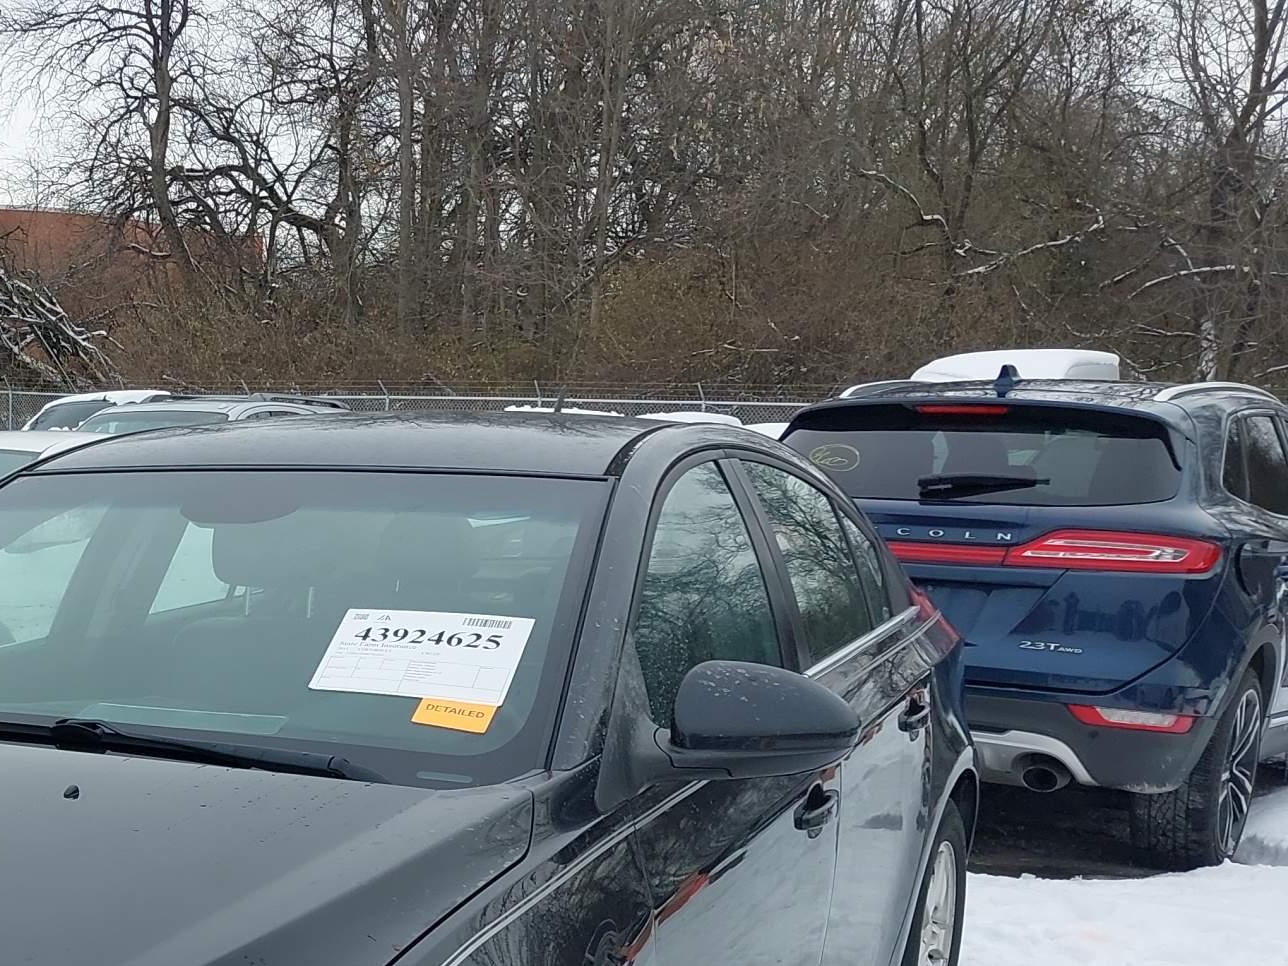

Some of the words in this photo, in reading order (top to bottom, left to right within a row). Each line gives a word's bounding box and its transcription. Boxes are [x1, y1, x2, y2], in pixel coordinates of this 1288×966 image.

[875, 526, 1012, 541] COLN
[355, 626, 504, 650] 43924625
[425, 703, 485, 719] DETAILED
